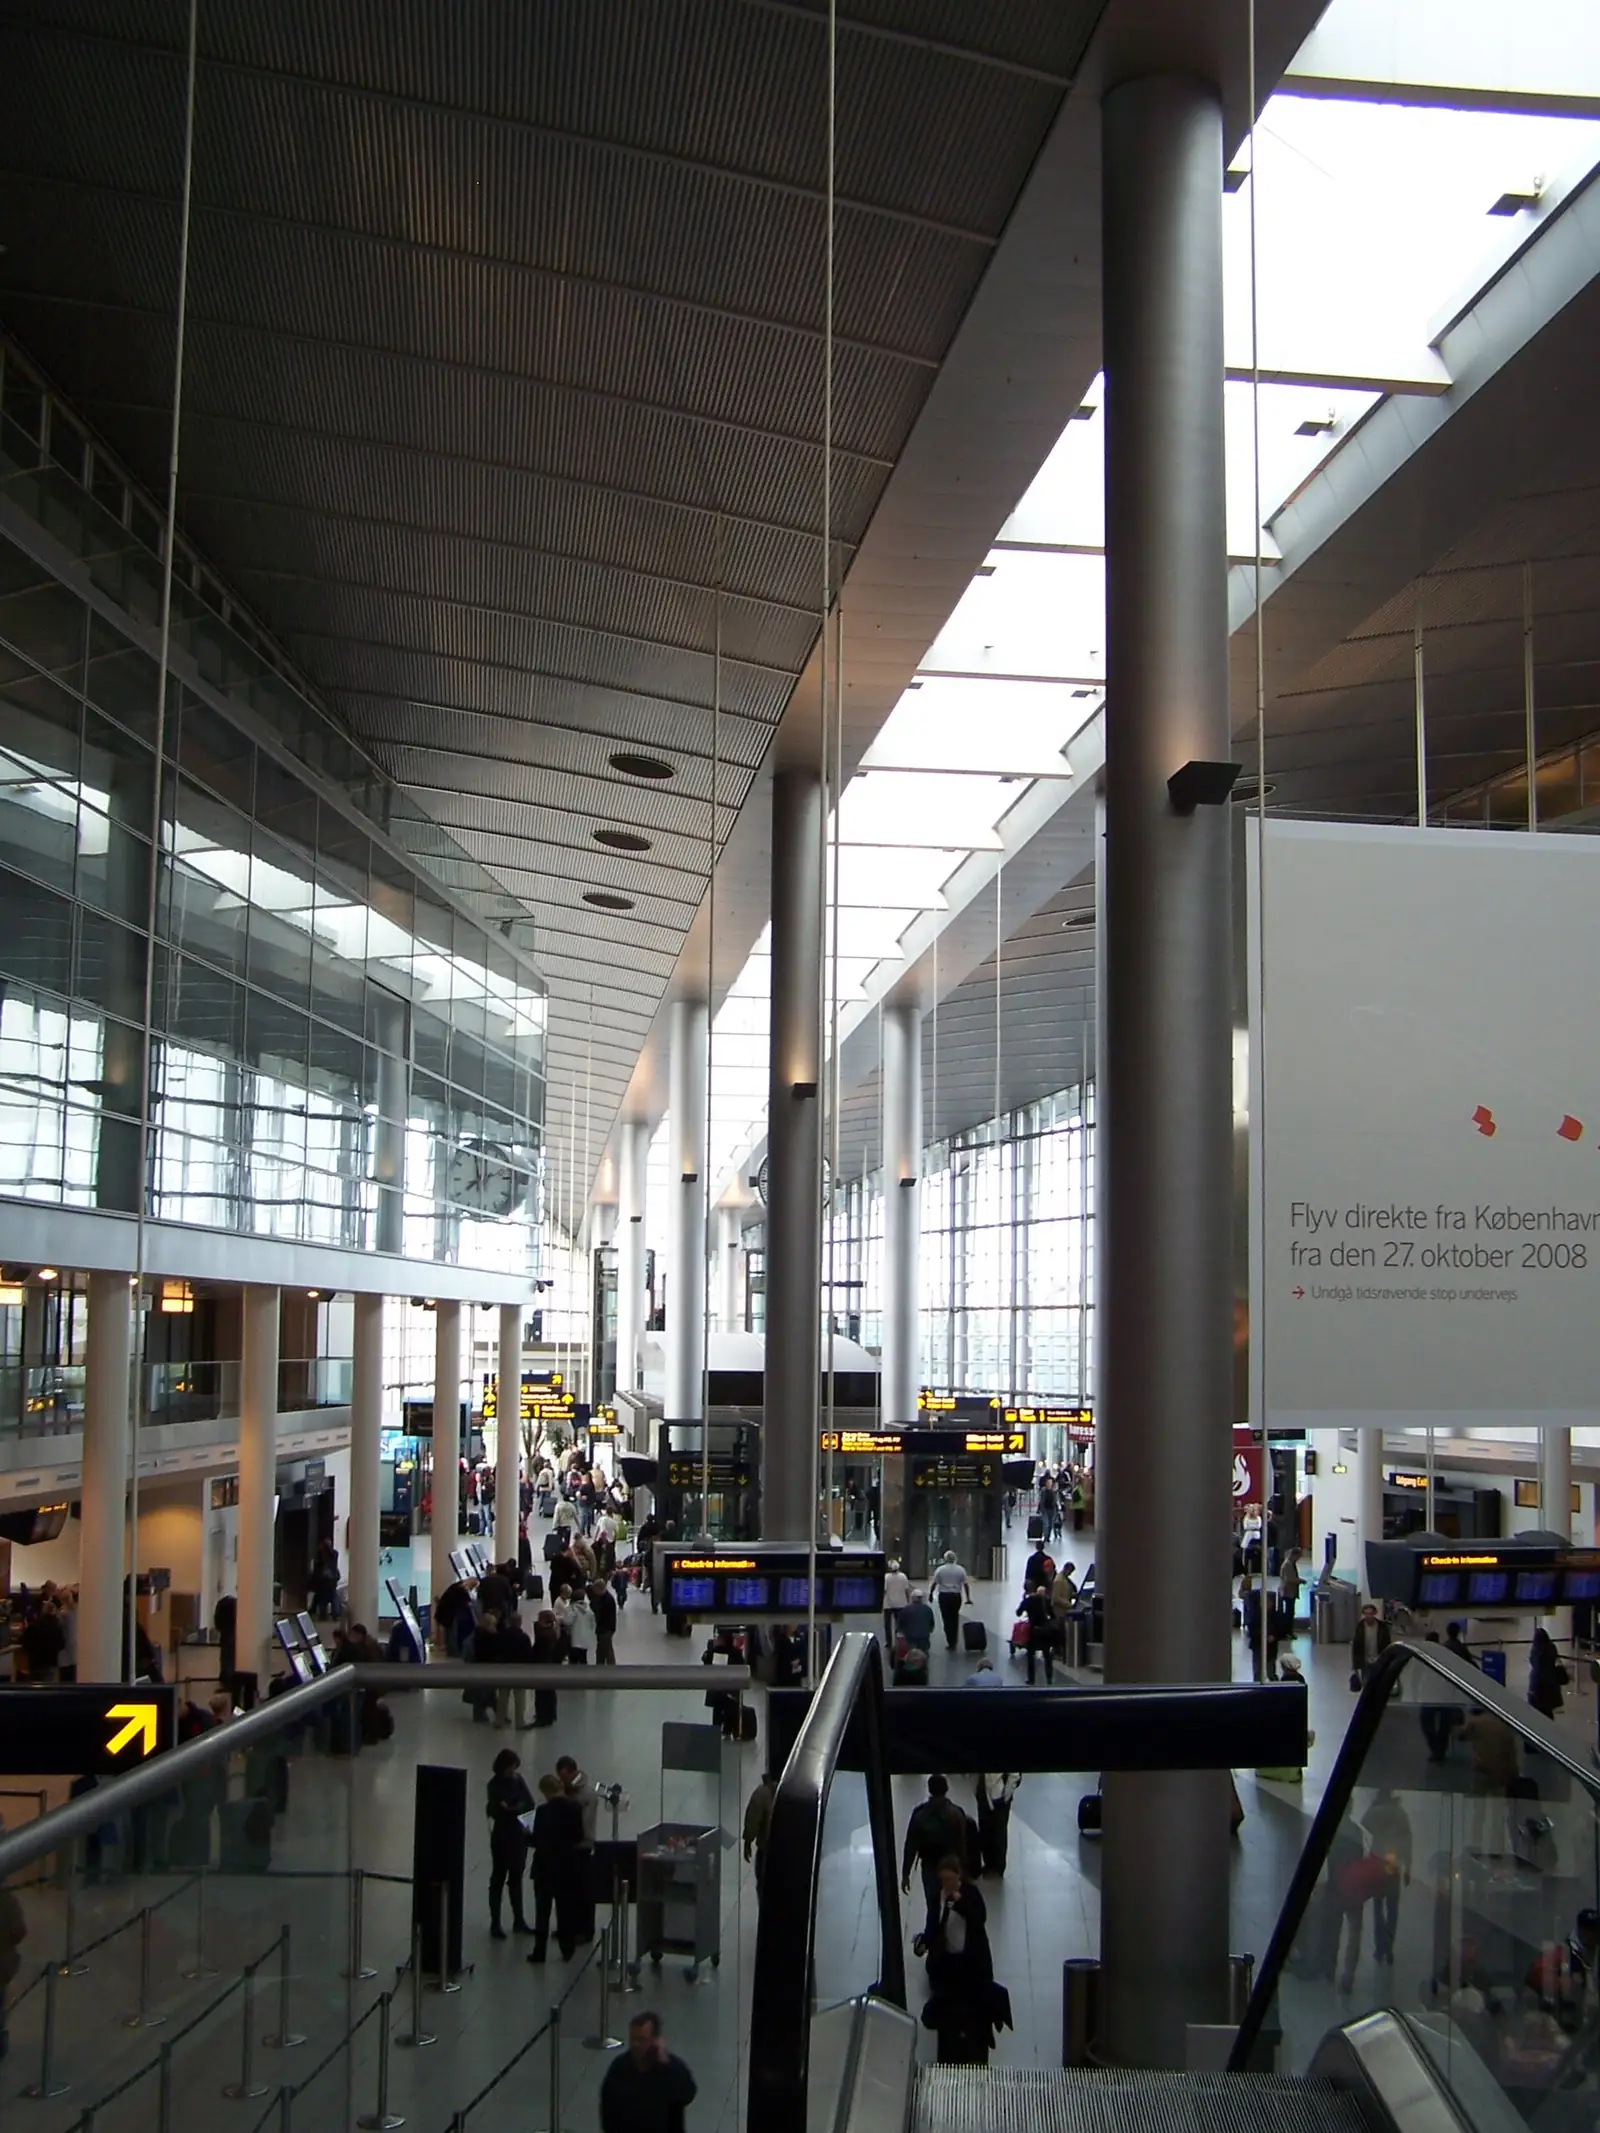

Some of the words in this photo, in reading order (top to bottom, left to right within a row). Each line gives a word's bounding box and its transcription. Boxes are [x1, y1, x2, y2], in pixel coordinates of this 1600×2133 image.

[1291, 1202, 1338, 1234] Flyv
[1345, 1204, 1427, 1230] direkte
[1435, 1205, 1466, 1230] fra
[1291, 1241, 1321, 1268] fra
[1330, 1241, 1375, 1268] den
[1383, 1241, 1414, 1268] 27.
[1421, 1244, 1514, 1269] oktober
[1521, 1243, 1588, 1269] 2008
[1311, 1285, 1353, 1302] Undgå
[1355, 1286, 1428, 1301] tidsrøvende
[1429, 1288, 1457, 1302] stop
[1459, 1287, 1518, 1303] undervejs
